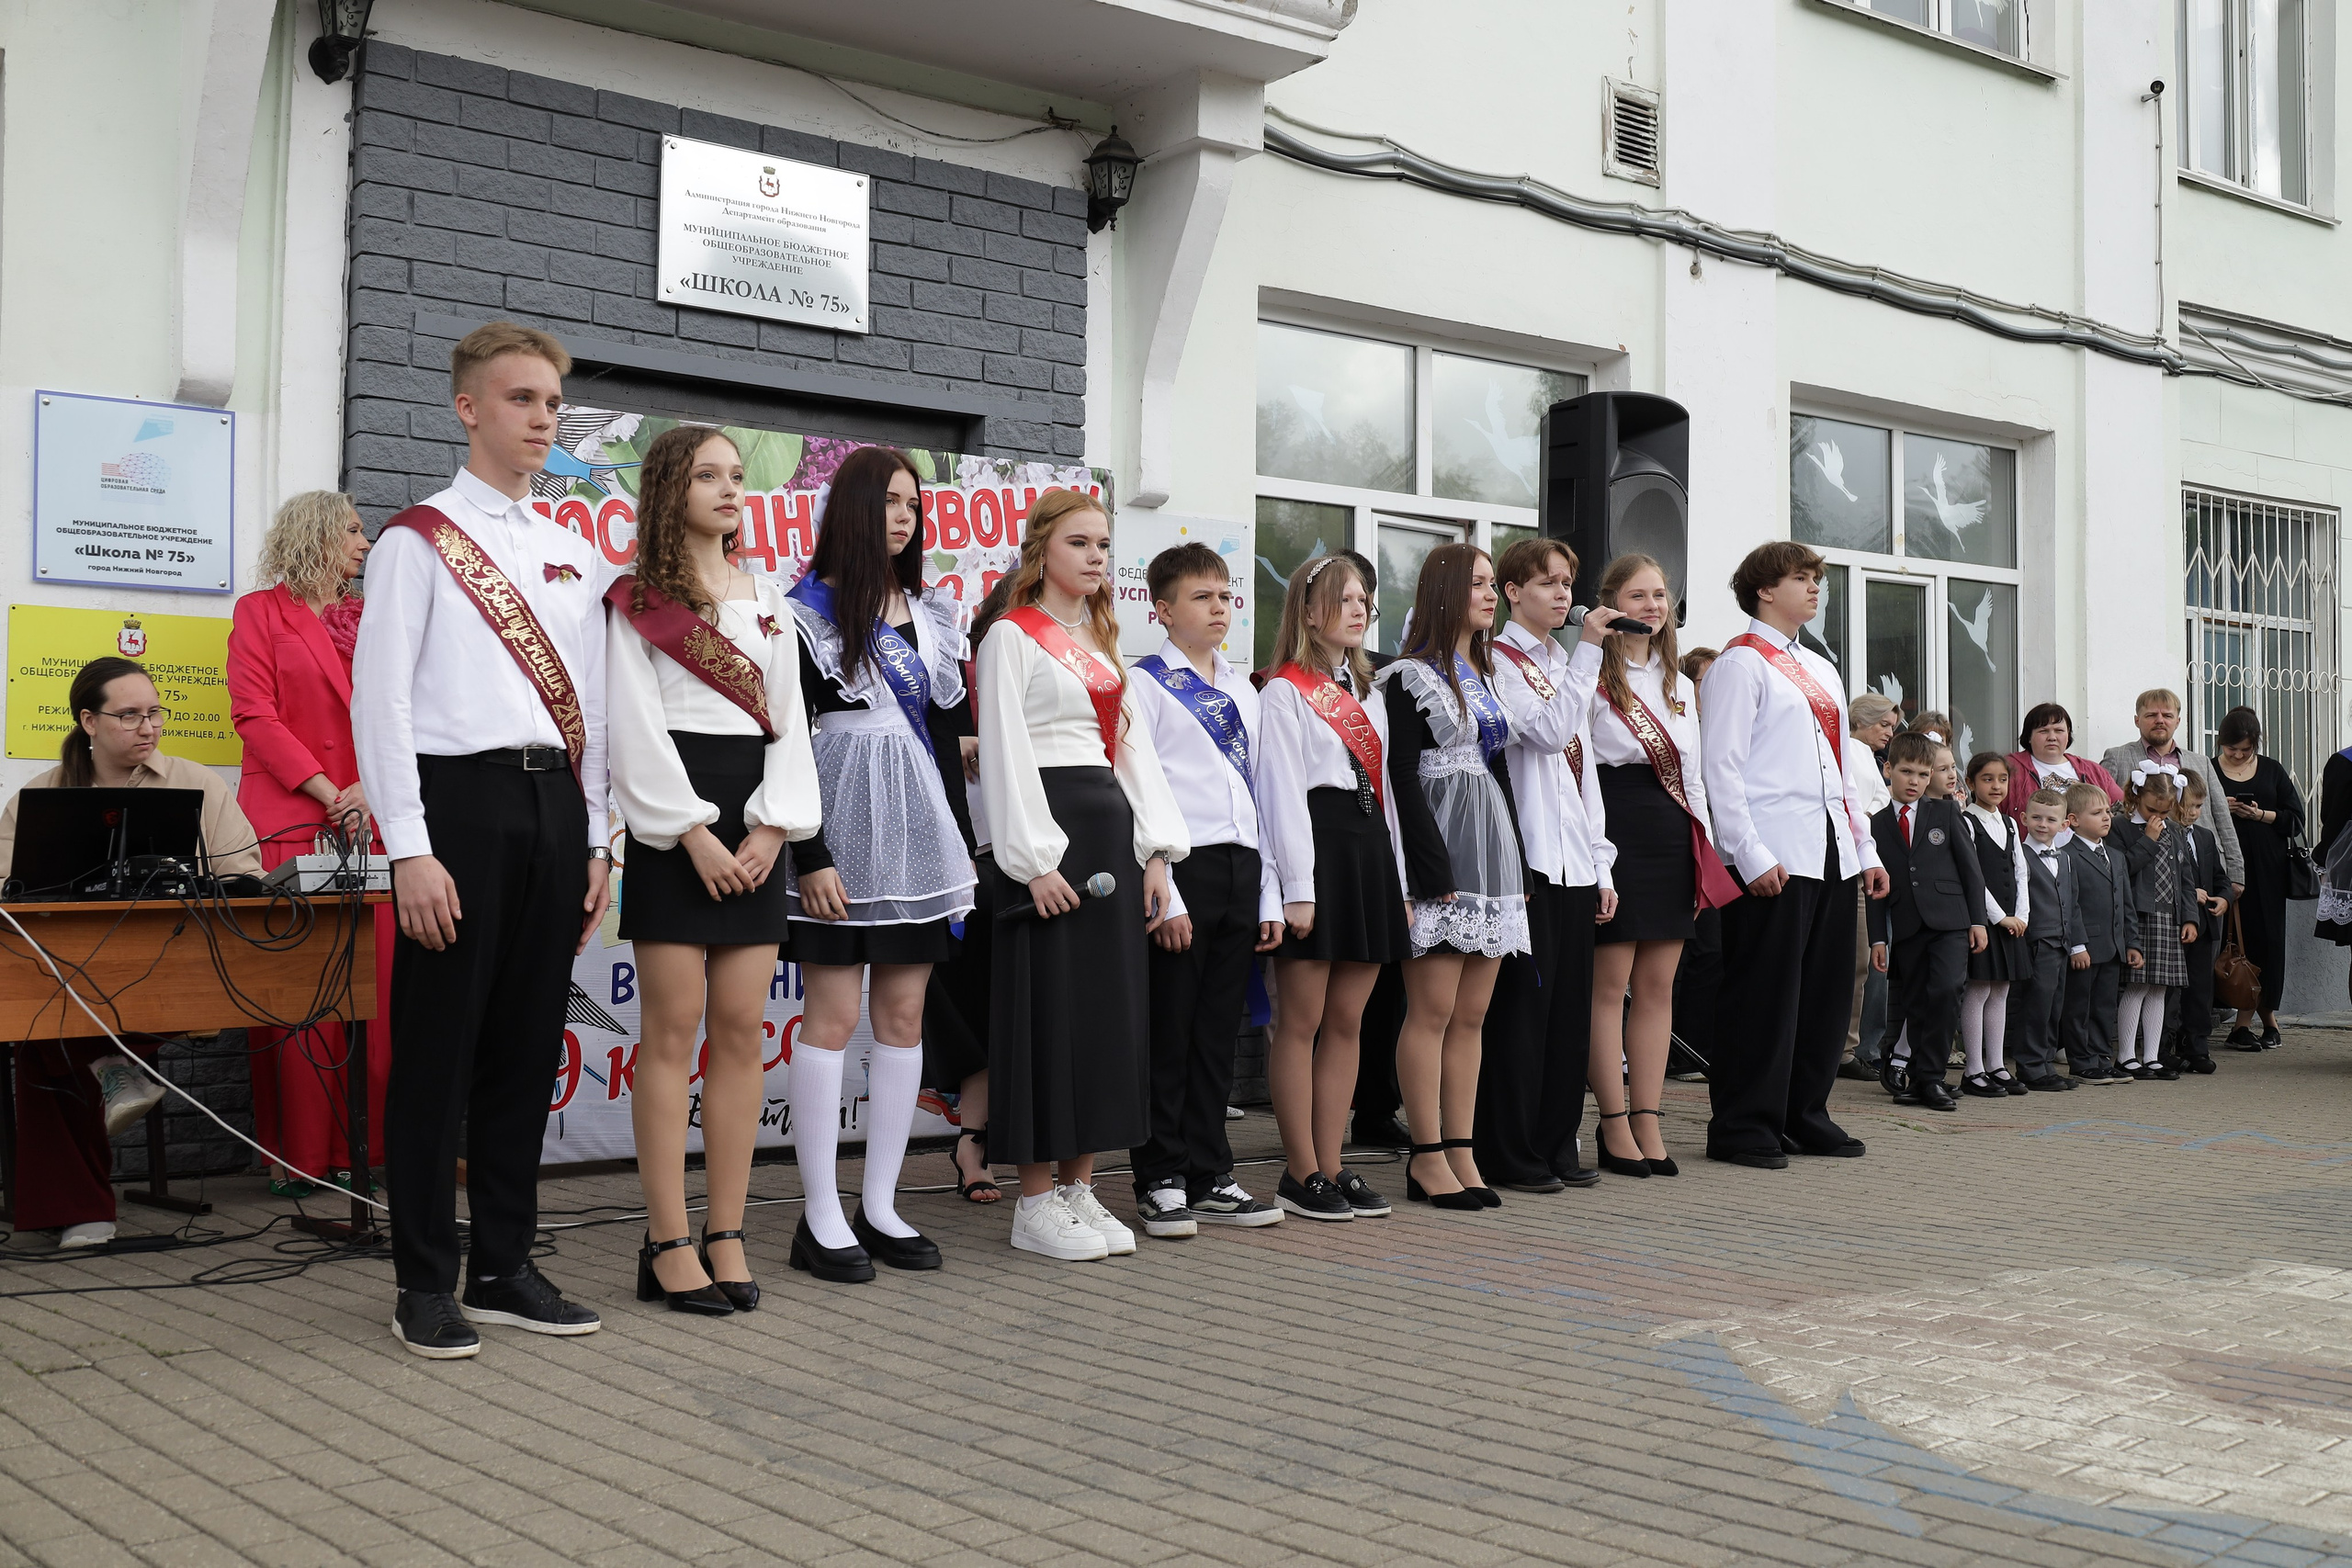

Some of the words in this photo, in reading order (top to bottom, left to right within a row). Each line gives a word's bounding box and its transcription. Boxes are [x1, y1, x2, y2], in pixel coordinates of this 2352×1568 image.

[684, 189, 751, 206] Администрация
[752, 203, 779, 212] города
[781, 207, 818, 220] Нижнего
[820, 214, 861, 229] Новгорода
[721, 207, 775, 224] Департамент
[777, 218, 827, 232] образования
[683, 222, 781, 248] МУНИЦИПАЛЬНОЕ
[783, 241, 850, 260] БЮДЖЕТНОЕ
[702, 239, 832, 268] ОБЩЕОБРАЗОВАТЕЛЬНОЕ
[731, 255, 804, 275] УЧРЕЖДЕНИЕ
[680, 272, 783, 304] «ШКОЛА
[788, 288, 814, 309] №
[820, 294, 851, 314] 75»
[100, 483, 149, 492] ОБРАЗОВАТЕЛЬНАЯ
[55, 526, 159, 541] ОБЩЕОБРАЗОВАТЕЛЬНОЕ
[160, 536, 213, 545] УЧРЕЖДЕНИЕ
[72, 519, 145, 531] МУНИЦИПАЛЬНОЕ
[146, 525, 198, 536] БЮДЖЕТНОЕ
[74, 544, 141, 559] «Школа
[145, 548, 164, 561] №
[168, 550, 196, 563] 75»
[87, 564, 111, 572] город
[112, 566, 144, 574] Нижний
[145, 568, 183, 577] Новгород
[1118, 586, 1153, 603] УСП
[149, 663, 219, 676] БЮДЖЕТНОЕ
[465, 566, 567, 700] Выпускник
[552, 692, 585, 763] 2025
[166, 674, 229, 686] УЧРЕЖДЕН
[164, 689, 188, 702] 75»
[38, 705, 71, 716] РЕЖИ
[173, 712, 190, 722] ДО
[193, 713, 220, 722] 20.00
[160, 728, 216, 739] ВИЖЕНЦЕВ,
